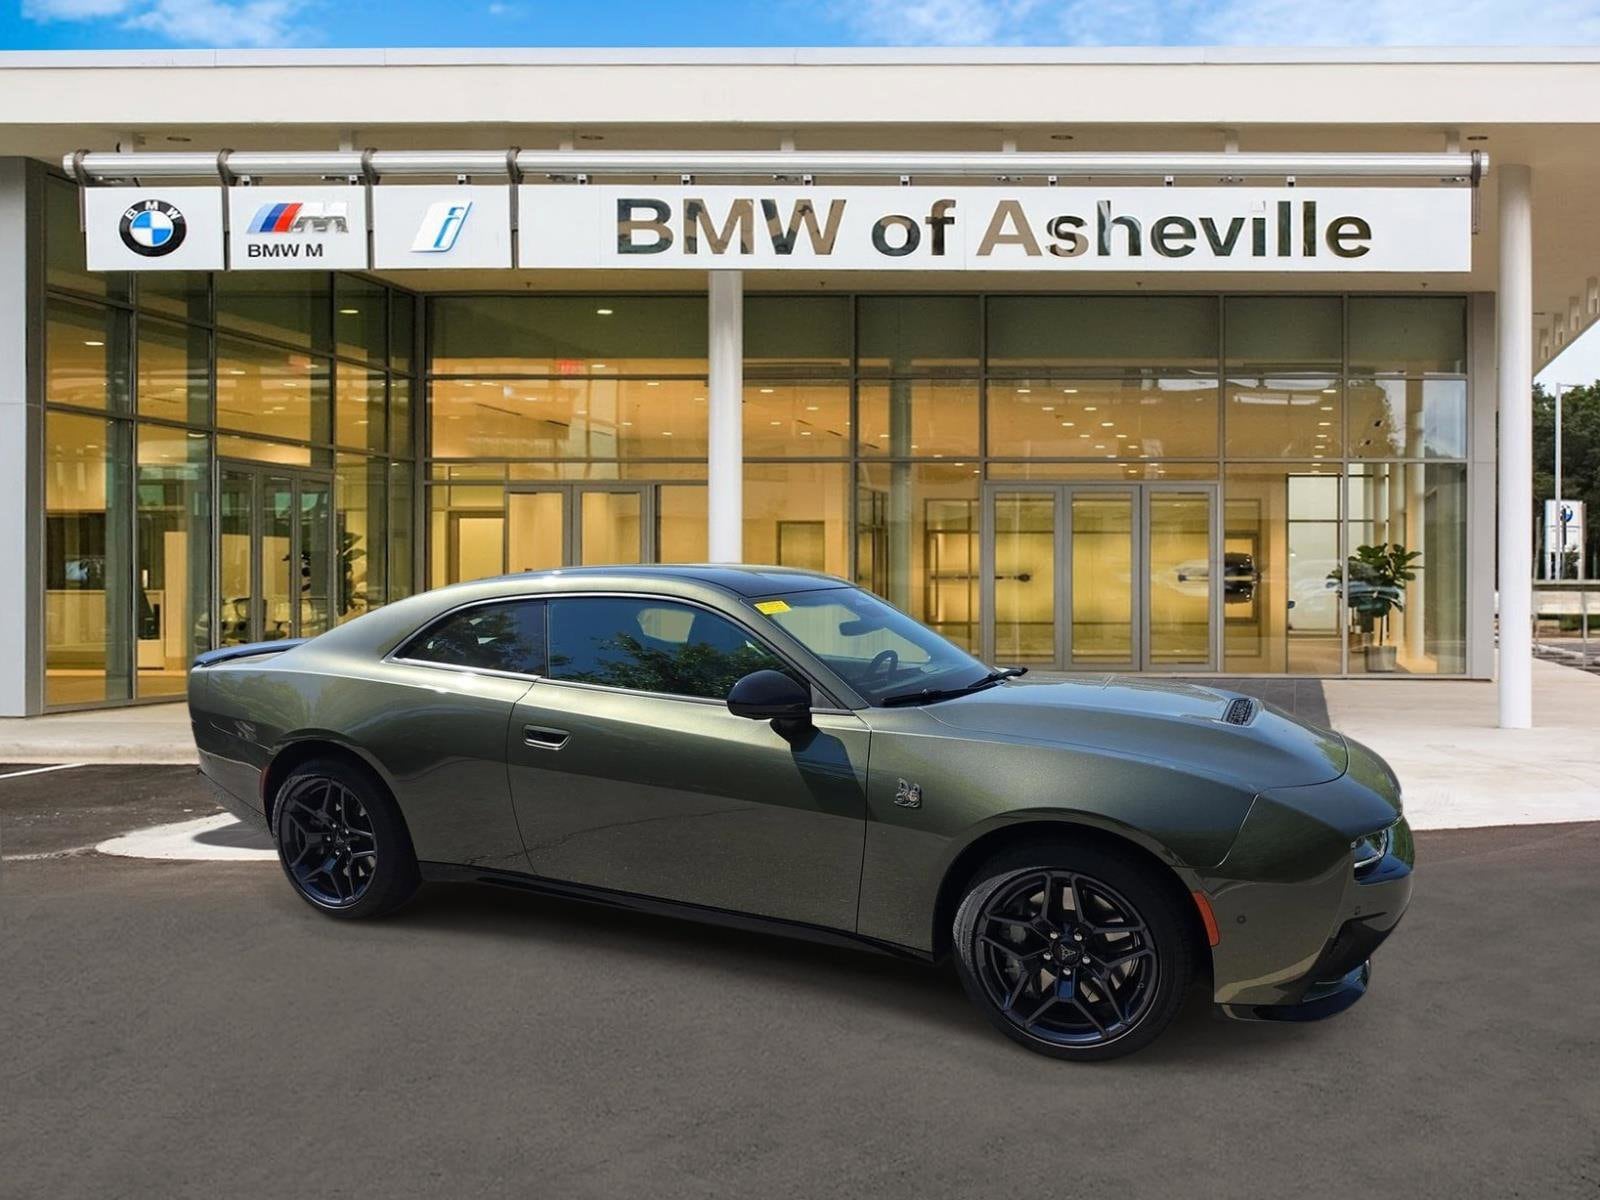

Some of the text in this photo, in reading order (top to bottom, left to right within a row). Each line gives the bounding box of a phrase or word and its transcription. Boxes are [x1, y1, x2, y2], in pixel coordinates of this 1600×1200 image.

[125, 201, 181, 220] BMW
[616, 198, 1372, 258] BMW of Asheville
[247, 243, 323, 258] BMW M
